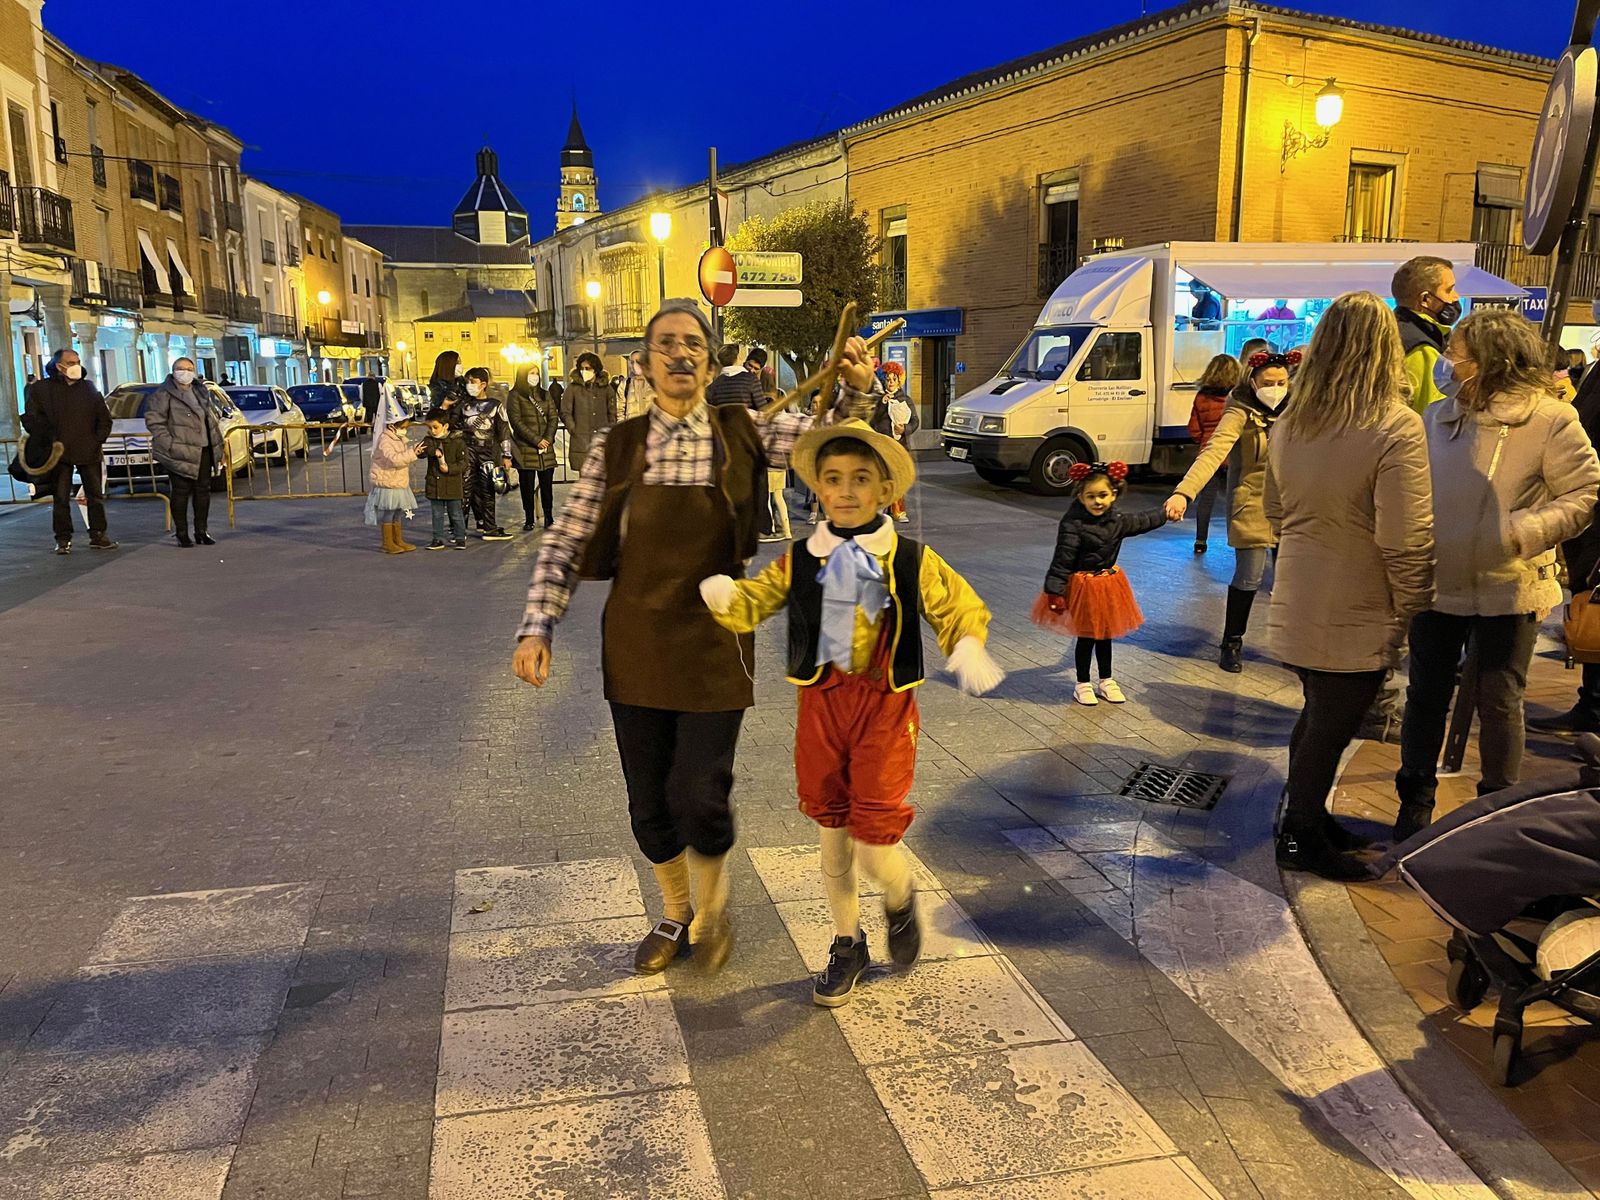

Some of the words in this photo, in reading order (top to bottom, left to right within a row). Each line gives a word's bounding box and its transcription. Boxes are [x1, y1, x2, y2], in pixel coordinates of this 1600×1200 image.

[740, 271, 767, 282] 472
[1523, 298, 1546, 311] TAXI
[872, 318, 907, 330] santala
